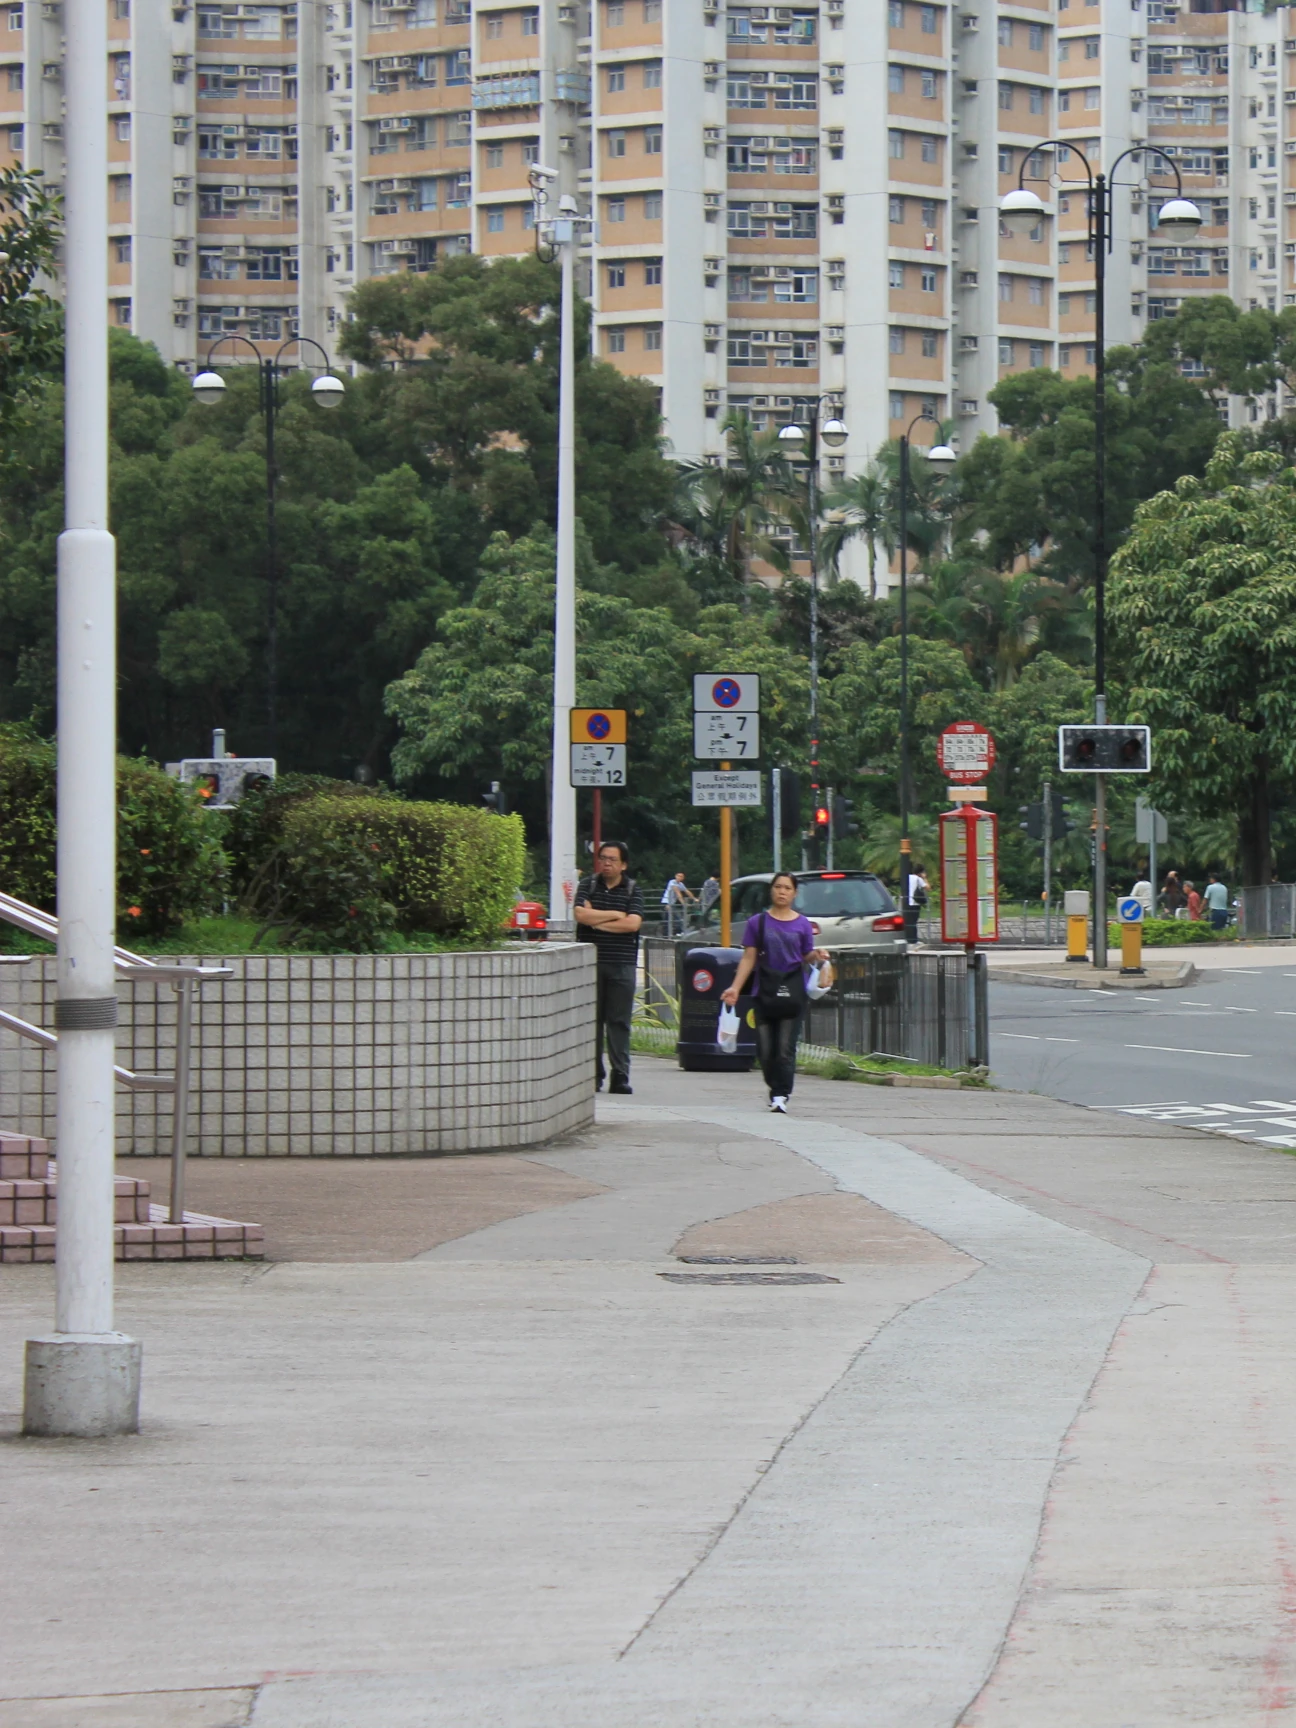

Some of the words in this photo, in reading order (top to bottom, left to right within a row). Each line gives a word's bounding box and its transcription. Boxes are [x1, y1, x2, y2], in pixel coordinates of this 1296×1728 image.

[708, 723, 726, 731] 上午
[736, 716, 746, 731] 7
[606, 747, 614, 760] 7
[708, 747, 726, 756] 下午
[736, 741, 746, 756] 7
[606, 770, 622, 784] 12
[714, 774, 740, 782] Except
